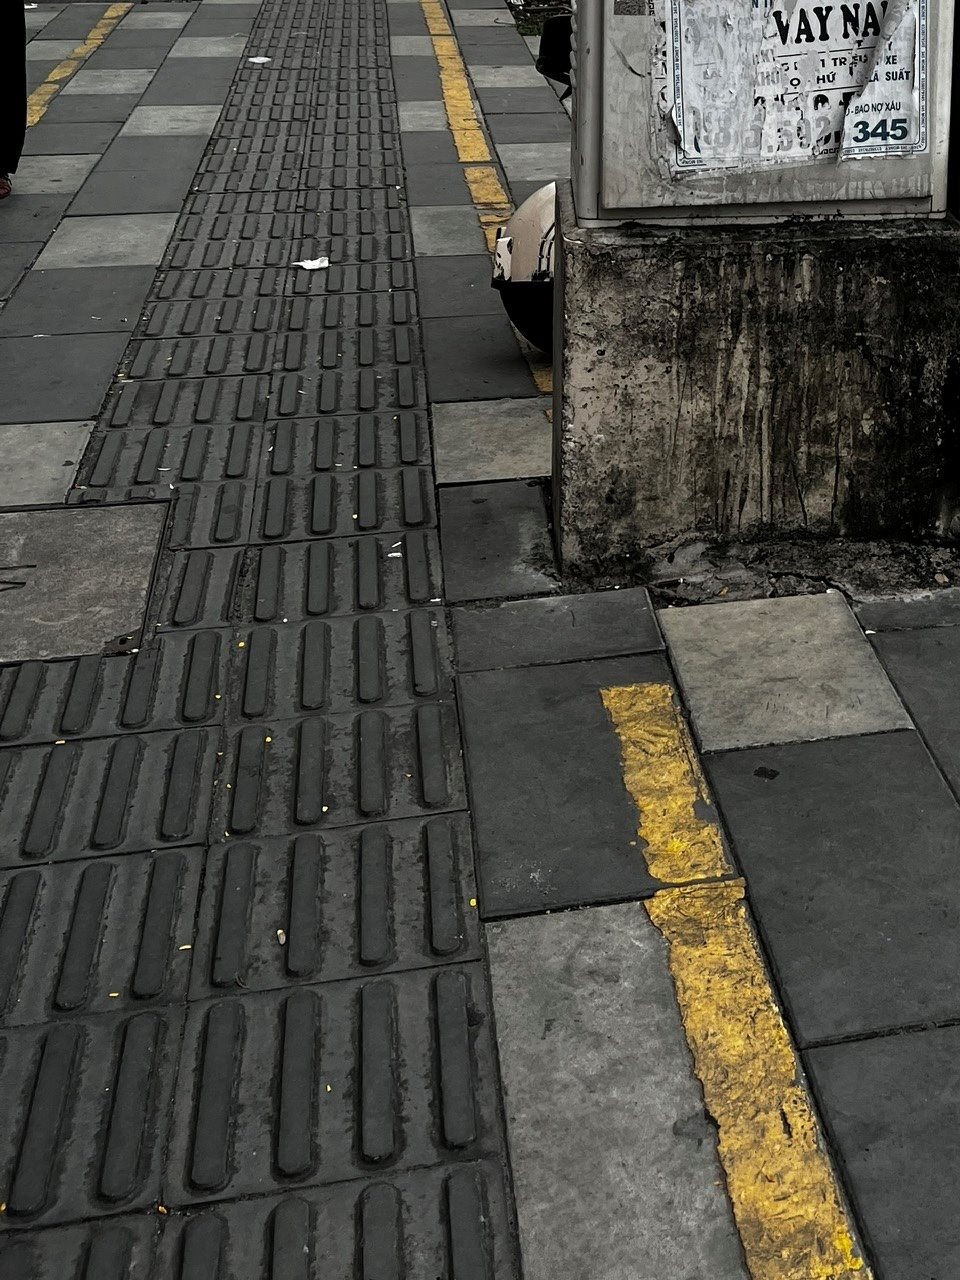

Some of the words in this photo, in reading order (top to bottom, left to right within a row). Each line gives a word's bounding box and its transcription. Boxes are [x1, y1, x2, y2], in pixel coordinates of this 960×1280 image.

[772, 5, 833, 45] VAY
[885, 67, 911, 81] SUẤT
[855, 103, 870, 114] BAO
[852, 118, 908, 143] 345
